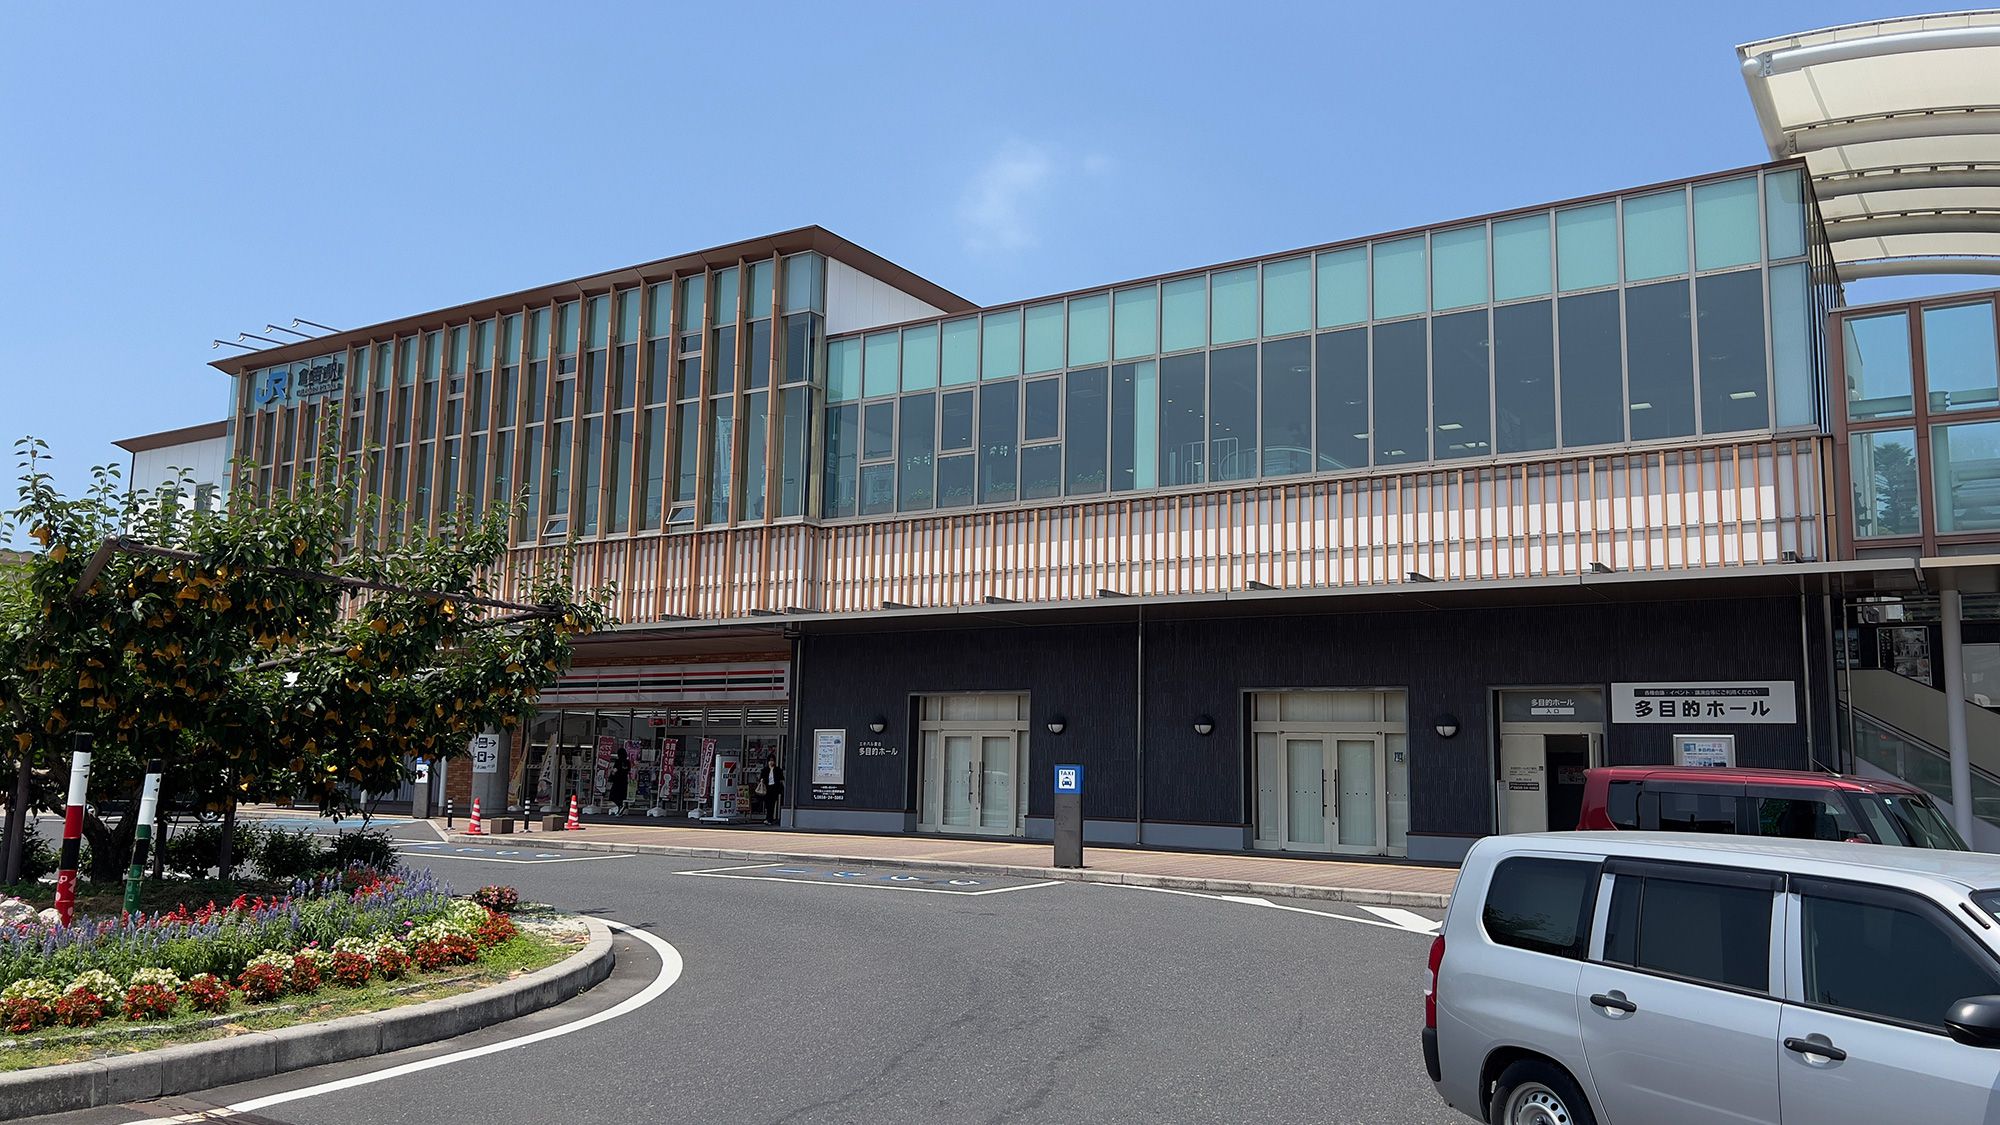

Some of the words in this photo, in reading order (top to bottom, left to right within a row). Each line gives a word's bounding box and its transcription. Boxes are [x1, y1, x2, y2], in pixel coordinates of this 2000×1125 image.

[256, 371, 288, 404] JR
[1531, 698, 1575, 707] 多目的ホール
[1634, 700, 1771, 718] 多目的ホール
[858, 747, 898, 756] 多目的ホール
